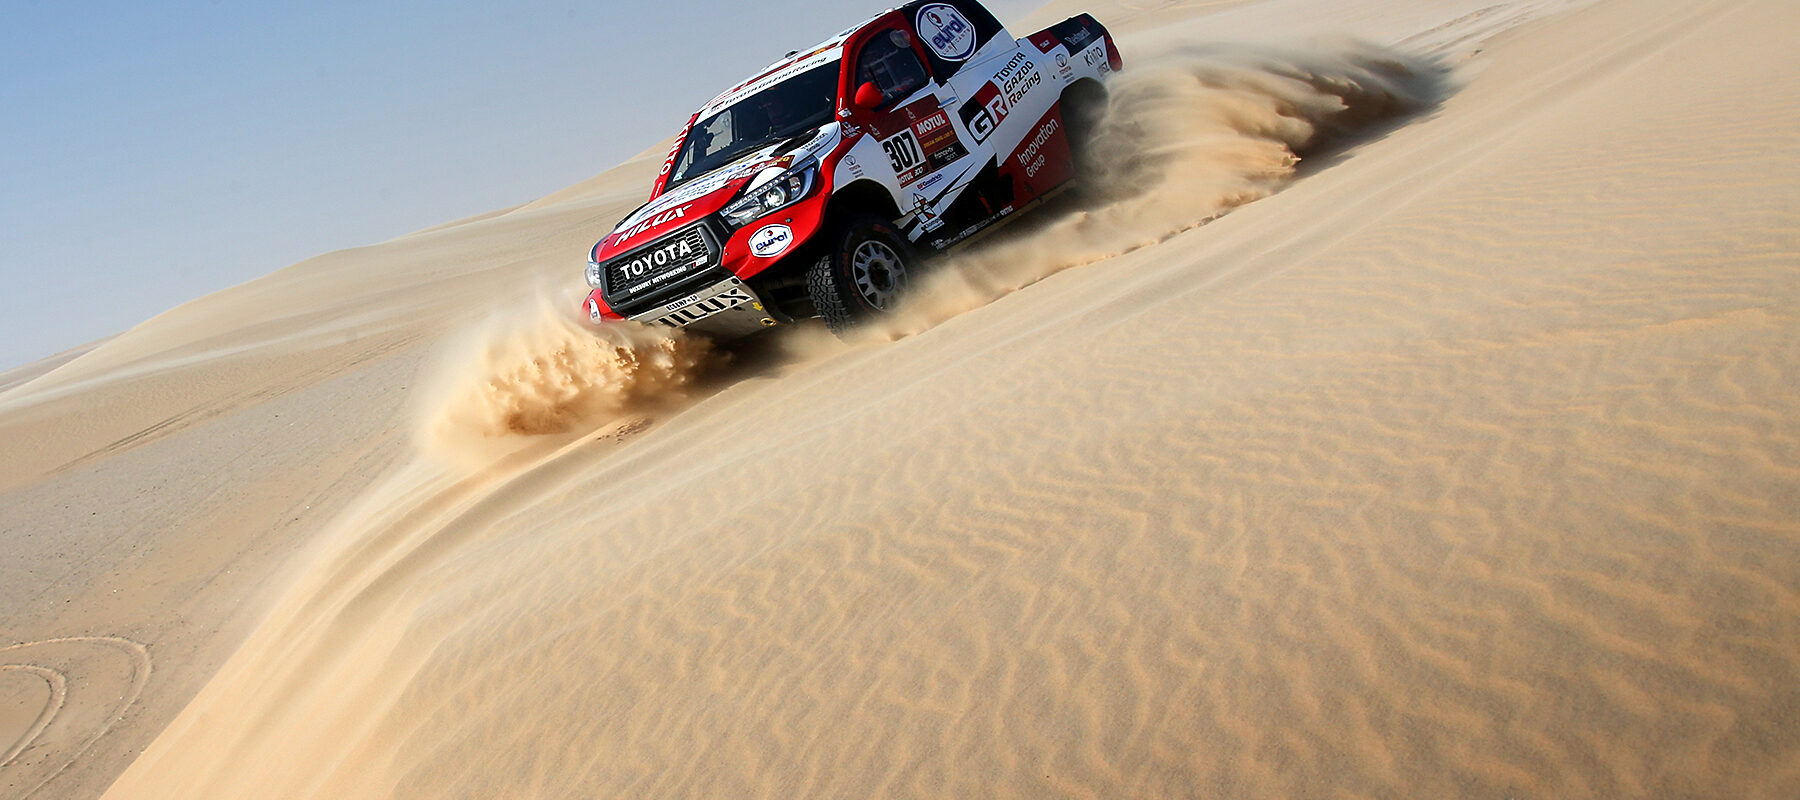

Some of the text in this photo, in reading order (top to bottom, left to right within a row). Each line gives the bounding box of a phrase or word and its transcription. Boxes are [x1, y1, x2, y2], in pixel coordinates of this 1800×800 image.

[932, 13, 966, 50] eurol
[993, 52, 1026, 81] TOYOTA
[1003, 61, 1034, 95] GAZOO
[1008, 71, 1041, 108] Racing
[916, 114, 946, 135] MOTUL
[968, 94, 1008, 141] GR
[882, 130, 920, 173] 307
[1017, 118, 1059, 167] Innovation
[1026, 154, 1045, 178] Group
[614, 204, 693, 247] HILUX
[756, 231, 788, 251] eurol
[620, 239, 692, 280] TOYOTA
[652, 266, 687, 285] NETWORKING
